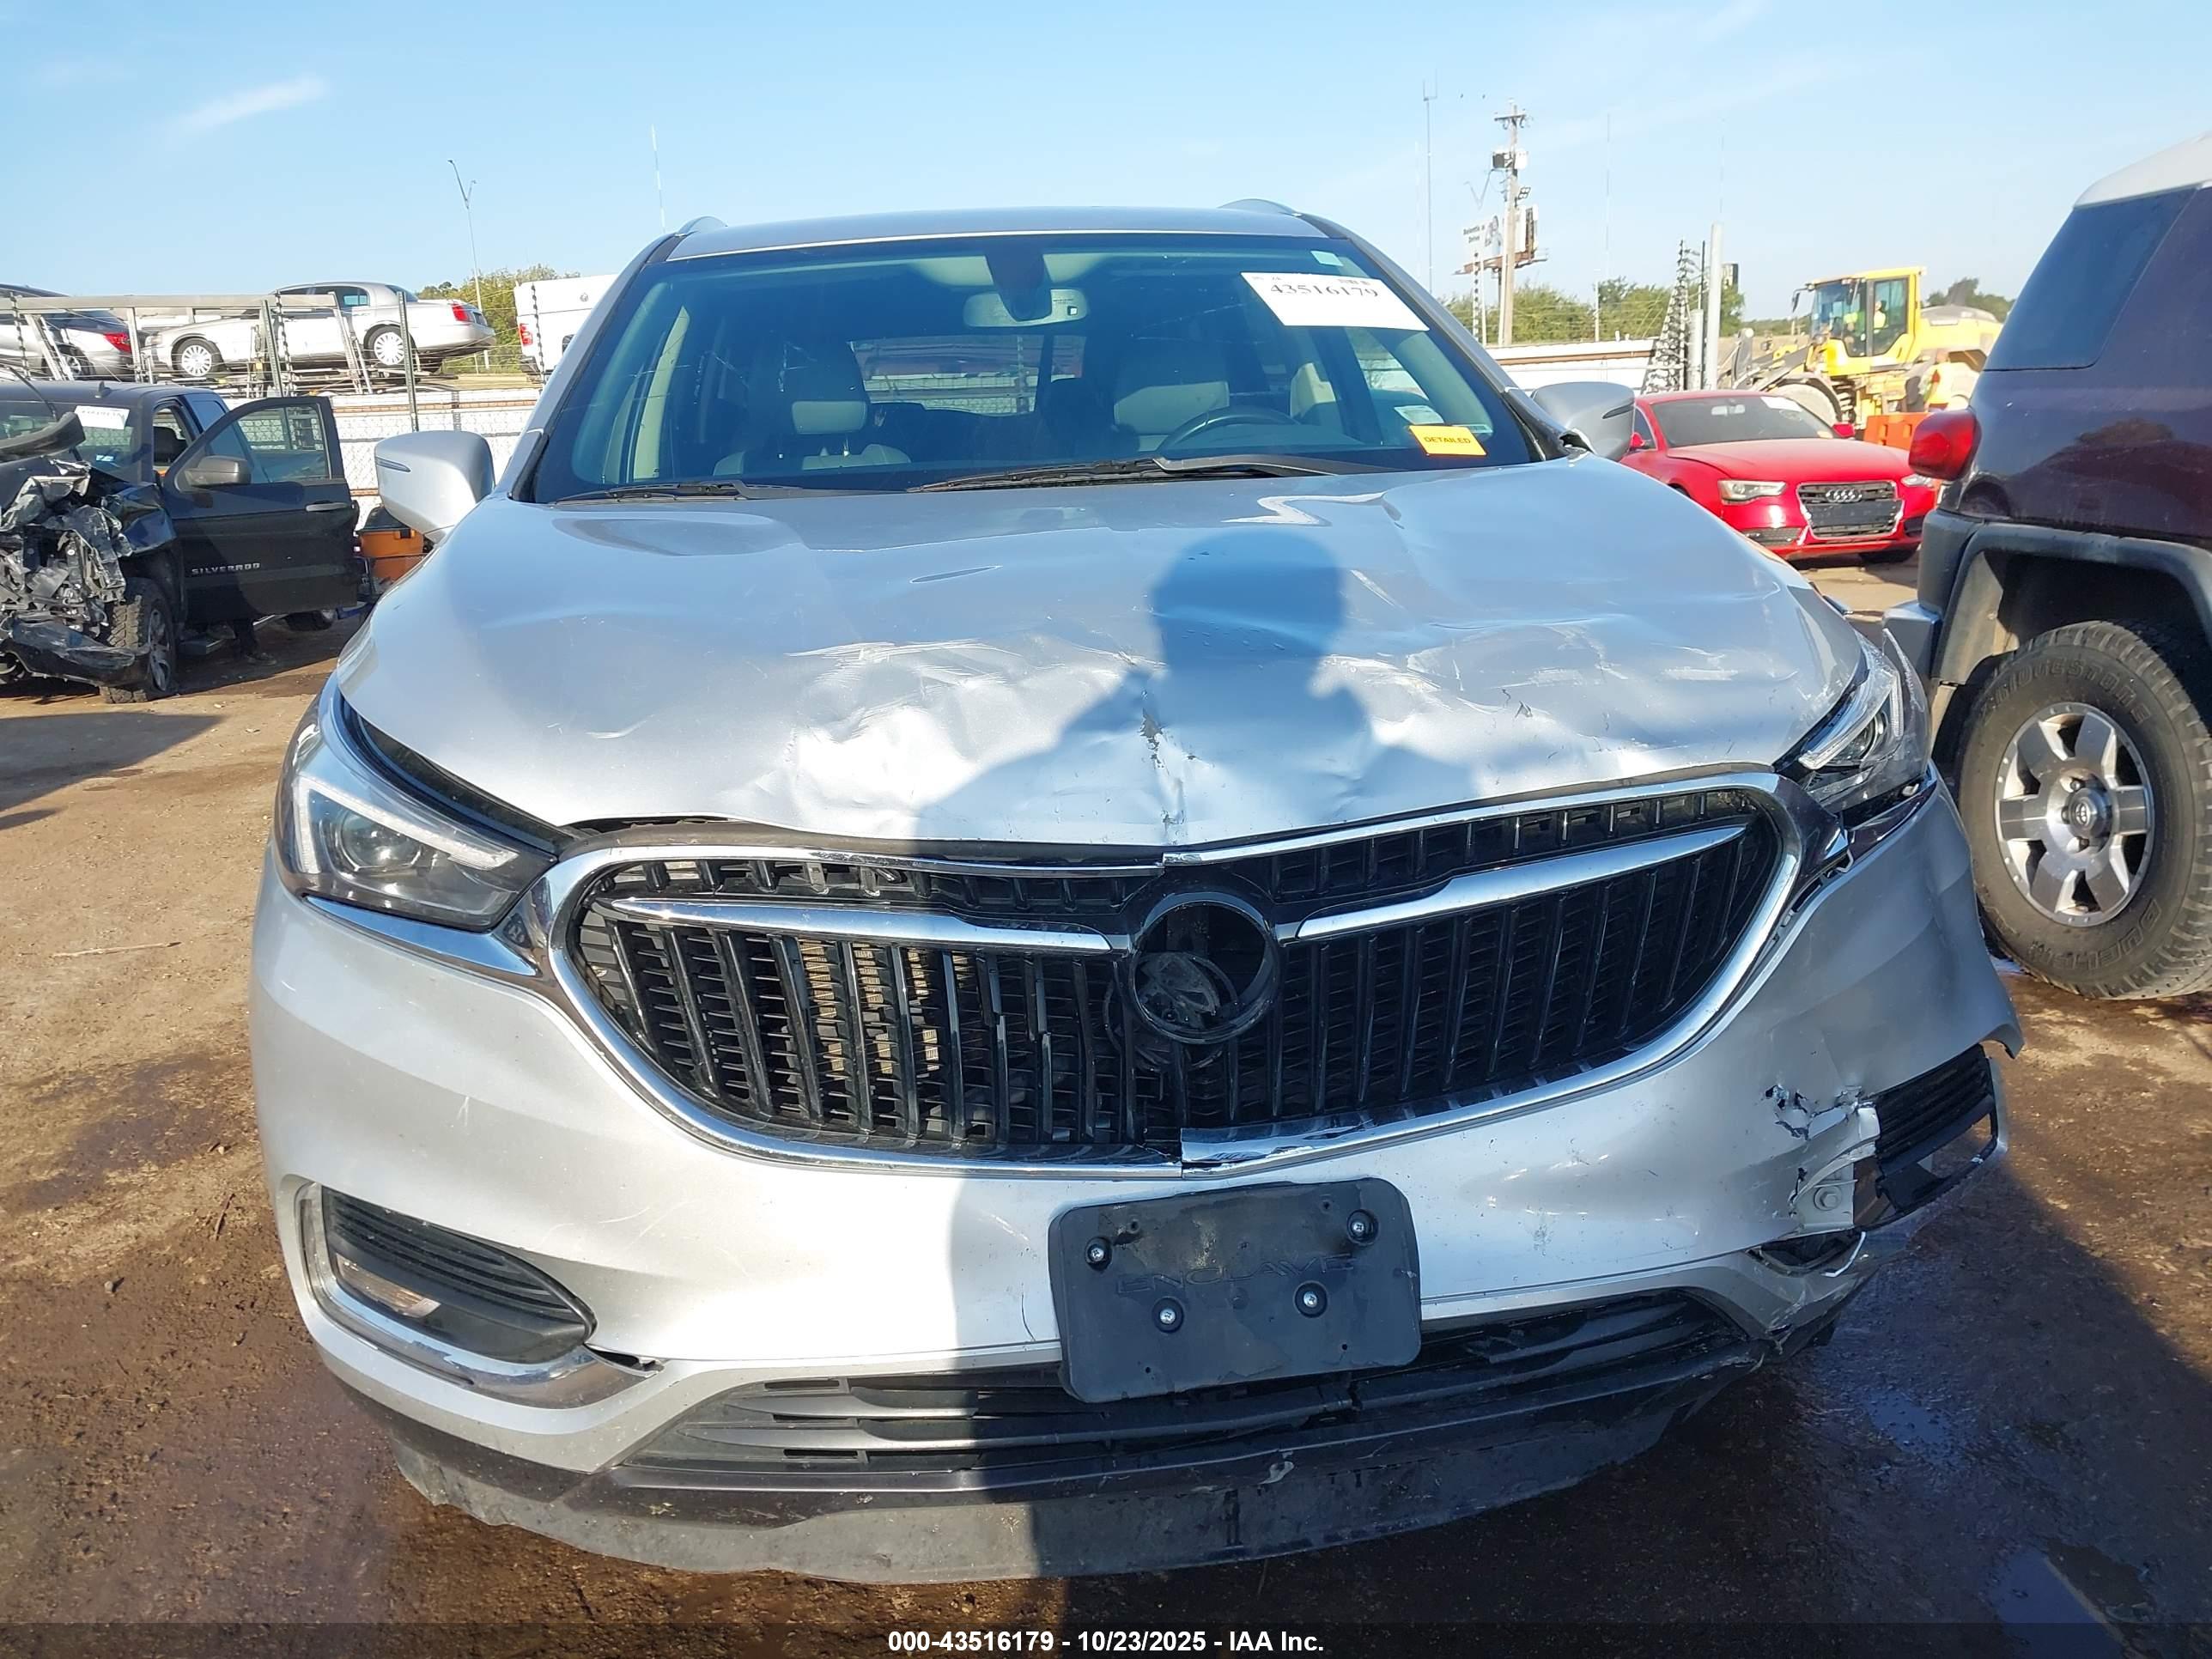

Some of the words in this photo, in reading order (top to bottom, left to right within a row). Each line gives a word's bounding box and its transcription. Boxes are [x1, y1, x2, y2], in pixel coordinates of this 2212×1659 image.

[1271, 283, 1378, 297] 43516179
[191, 562, 261, 575] SILVERADO
[1117, 1252, 1356, 1294] ENCLAVE
